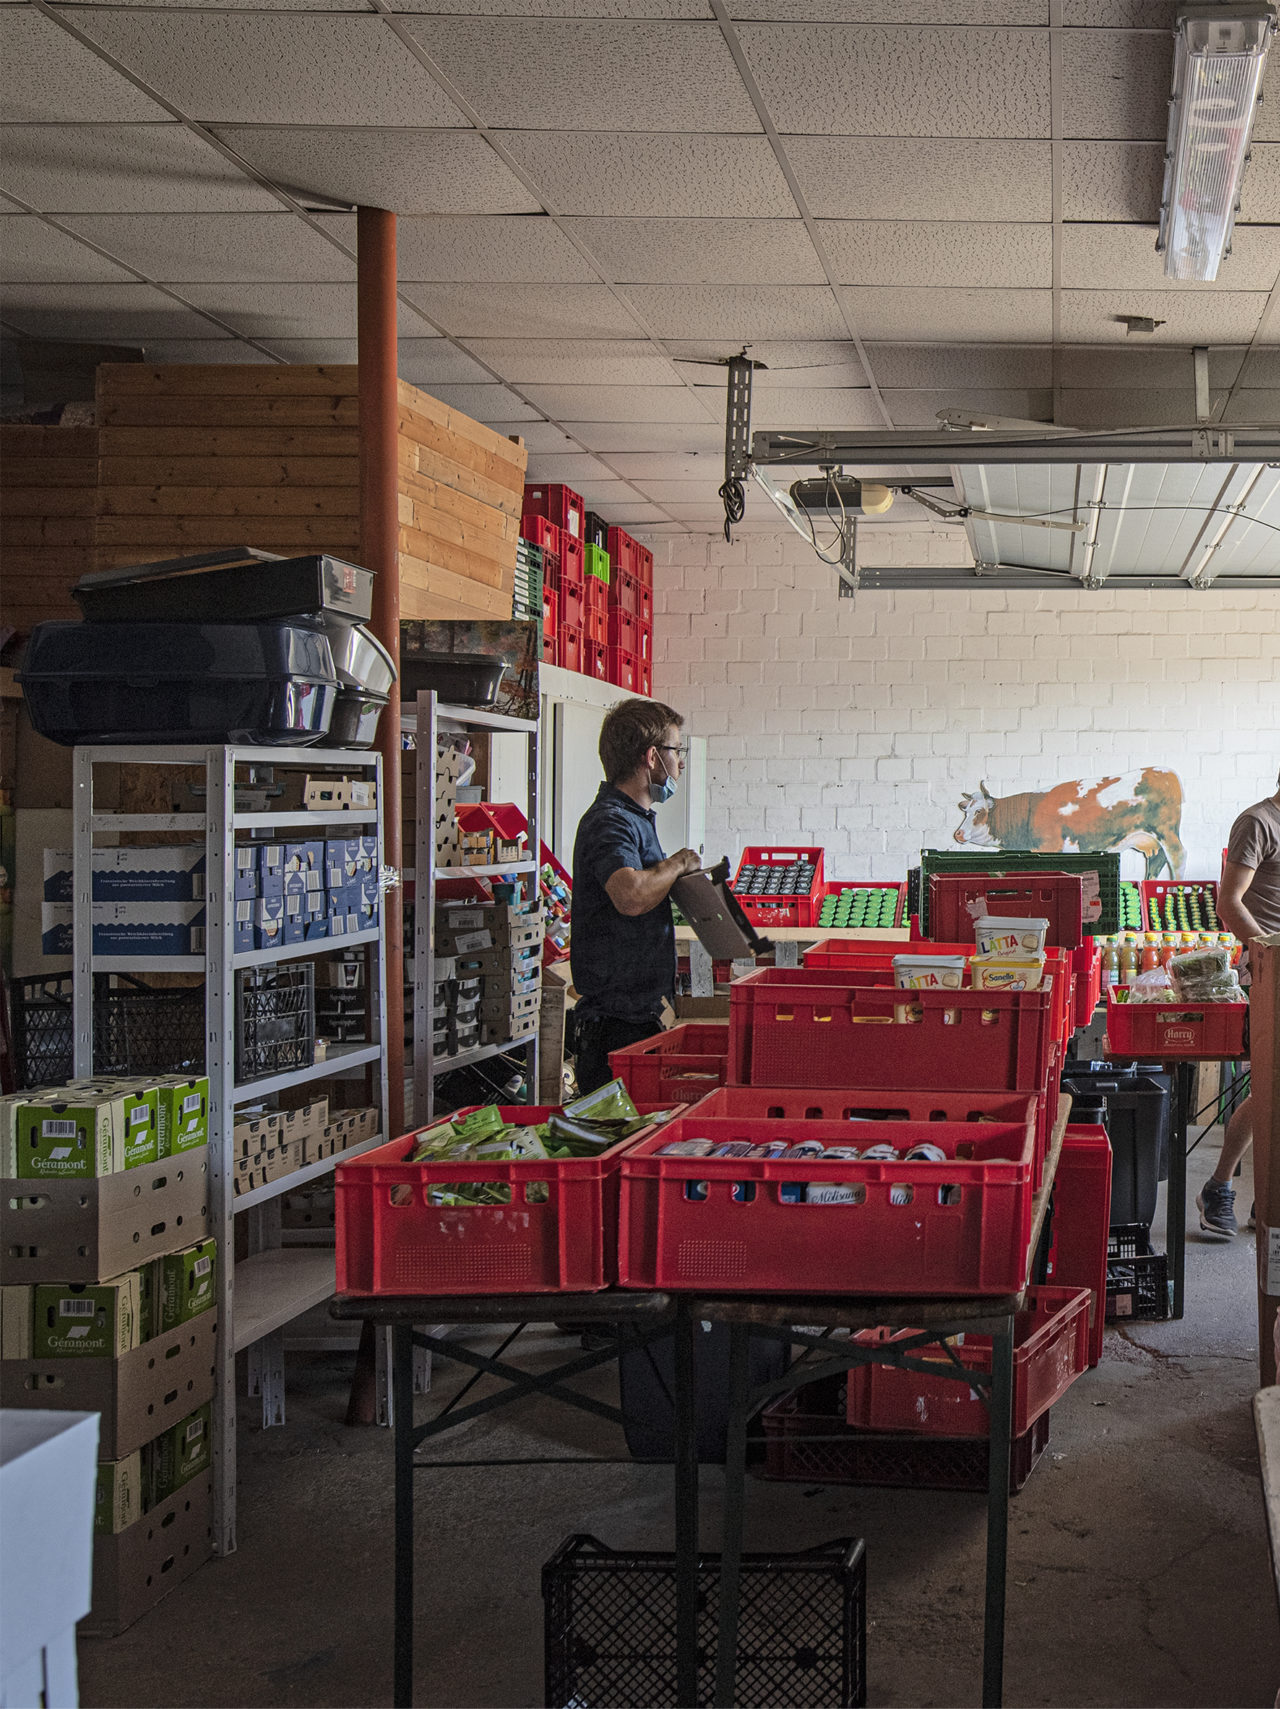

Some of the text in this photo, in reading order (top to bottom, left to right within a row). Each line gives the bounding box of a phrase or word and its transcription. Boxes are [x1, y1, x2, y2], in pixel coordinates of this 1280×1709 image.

[981, 934, 1019, 954] LÄTTA
[1167, 1028, 1193, 1041] Harry
[177, 1127, 205, 1144] Géramont
[102, 1117, 110, 1172] Géramont
[125, 1139, 154, 1157] Géramont
[31, 1157, 87, 1171] Géramont
[47, 1336, 105, 1348] Géramont
